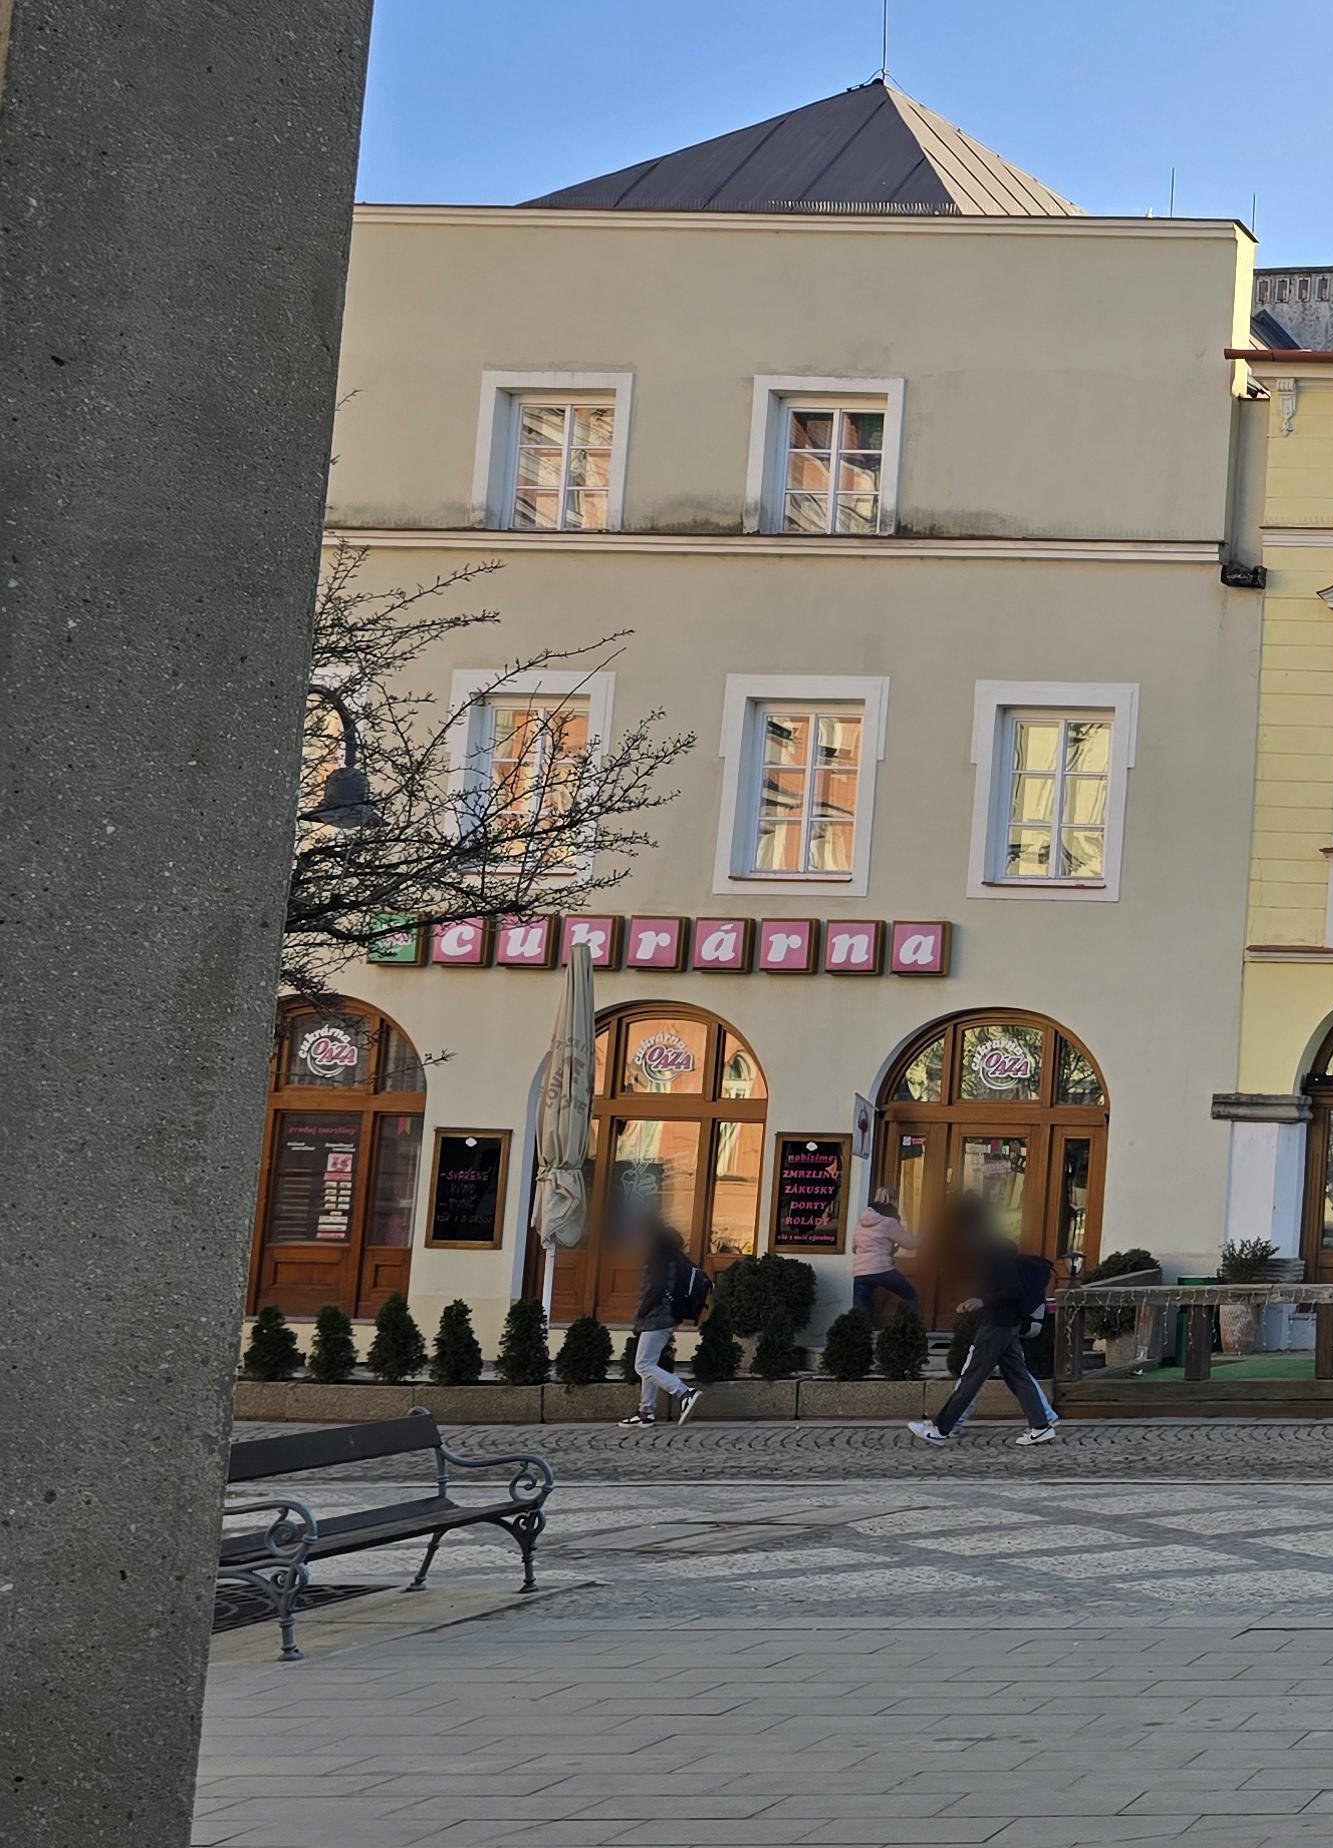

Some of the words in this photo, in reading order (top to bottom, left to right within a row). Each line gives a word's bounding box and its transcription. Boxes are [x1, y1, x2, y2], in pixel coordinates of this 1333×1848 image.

[440, 923, 935, 965] cukrárna
[785, 1184, 836, 1194] ZÁKUSKY
[790, 1201, 827, 1210] DORTY
